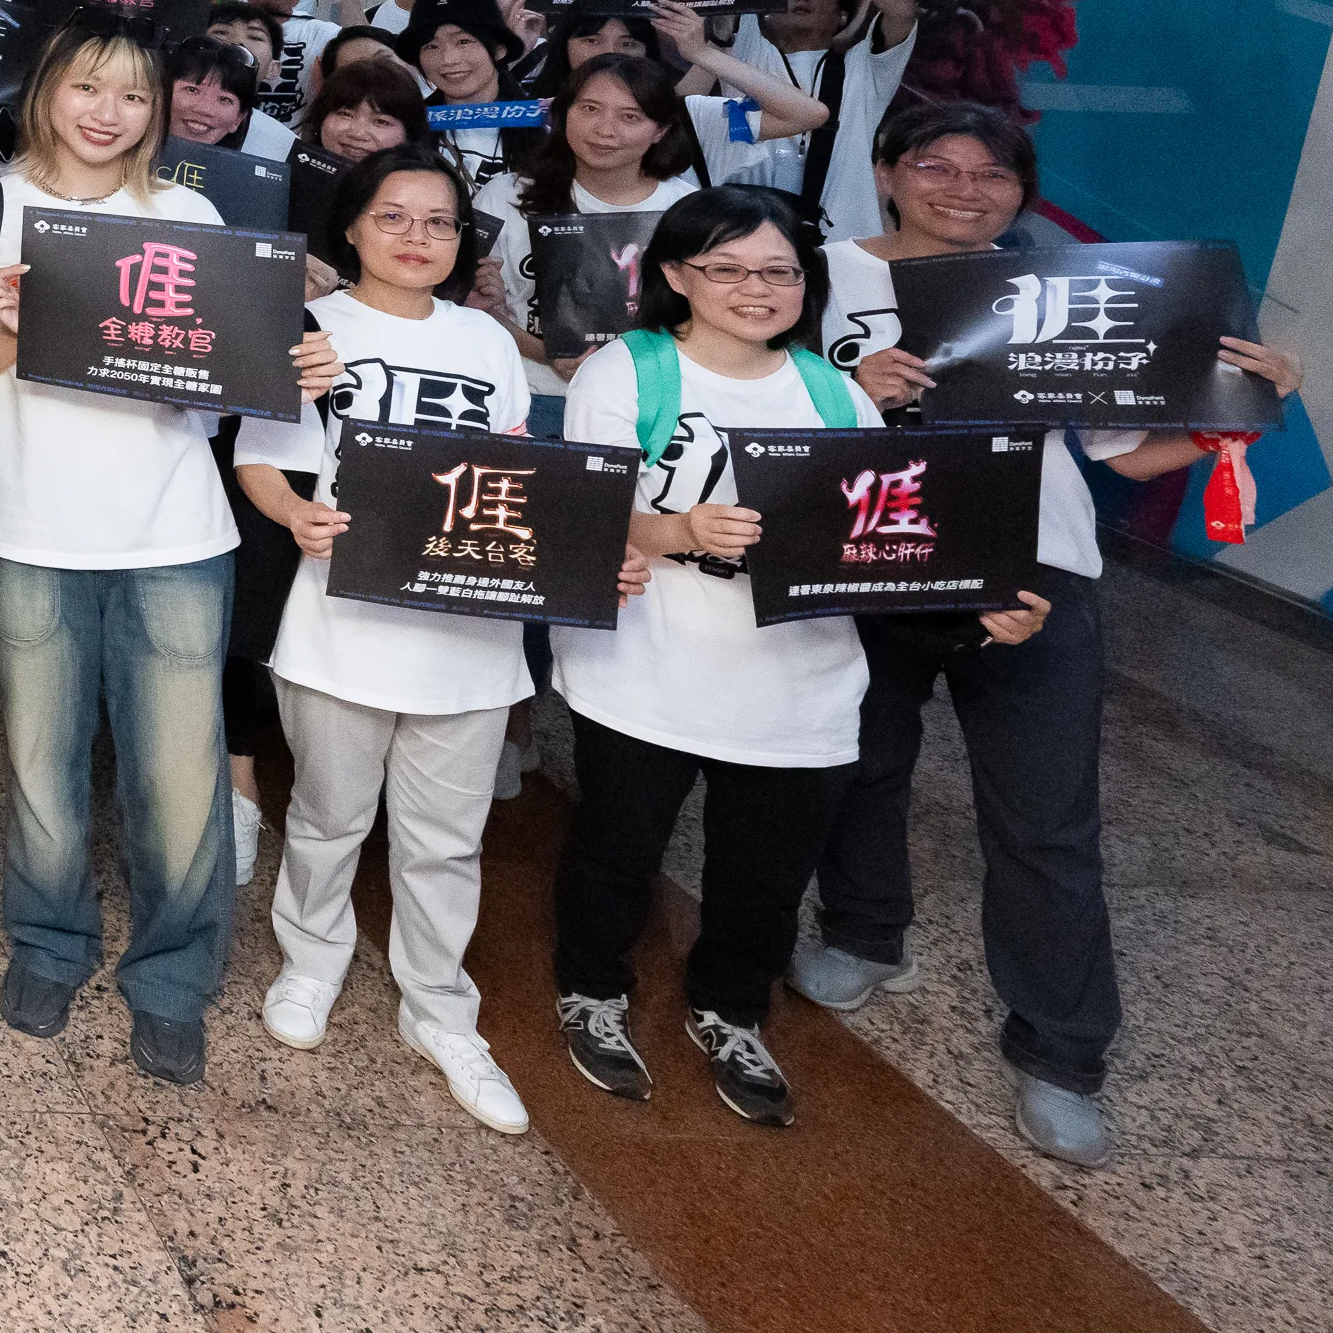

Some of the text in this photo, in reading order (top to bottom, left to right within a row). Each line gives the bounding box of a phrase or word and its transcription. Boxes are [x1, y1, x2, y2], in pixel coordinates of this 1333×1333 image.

[99, 317, 216, 353] 全糖教官
[102, 356, 210, 381] 手搖杯固定全糖販售
[1007, 351, 1151, 372] 浪漫份子
[421, 535, 538, 566] 後天台客
